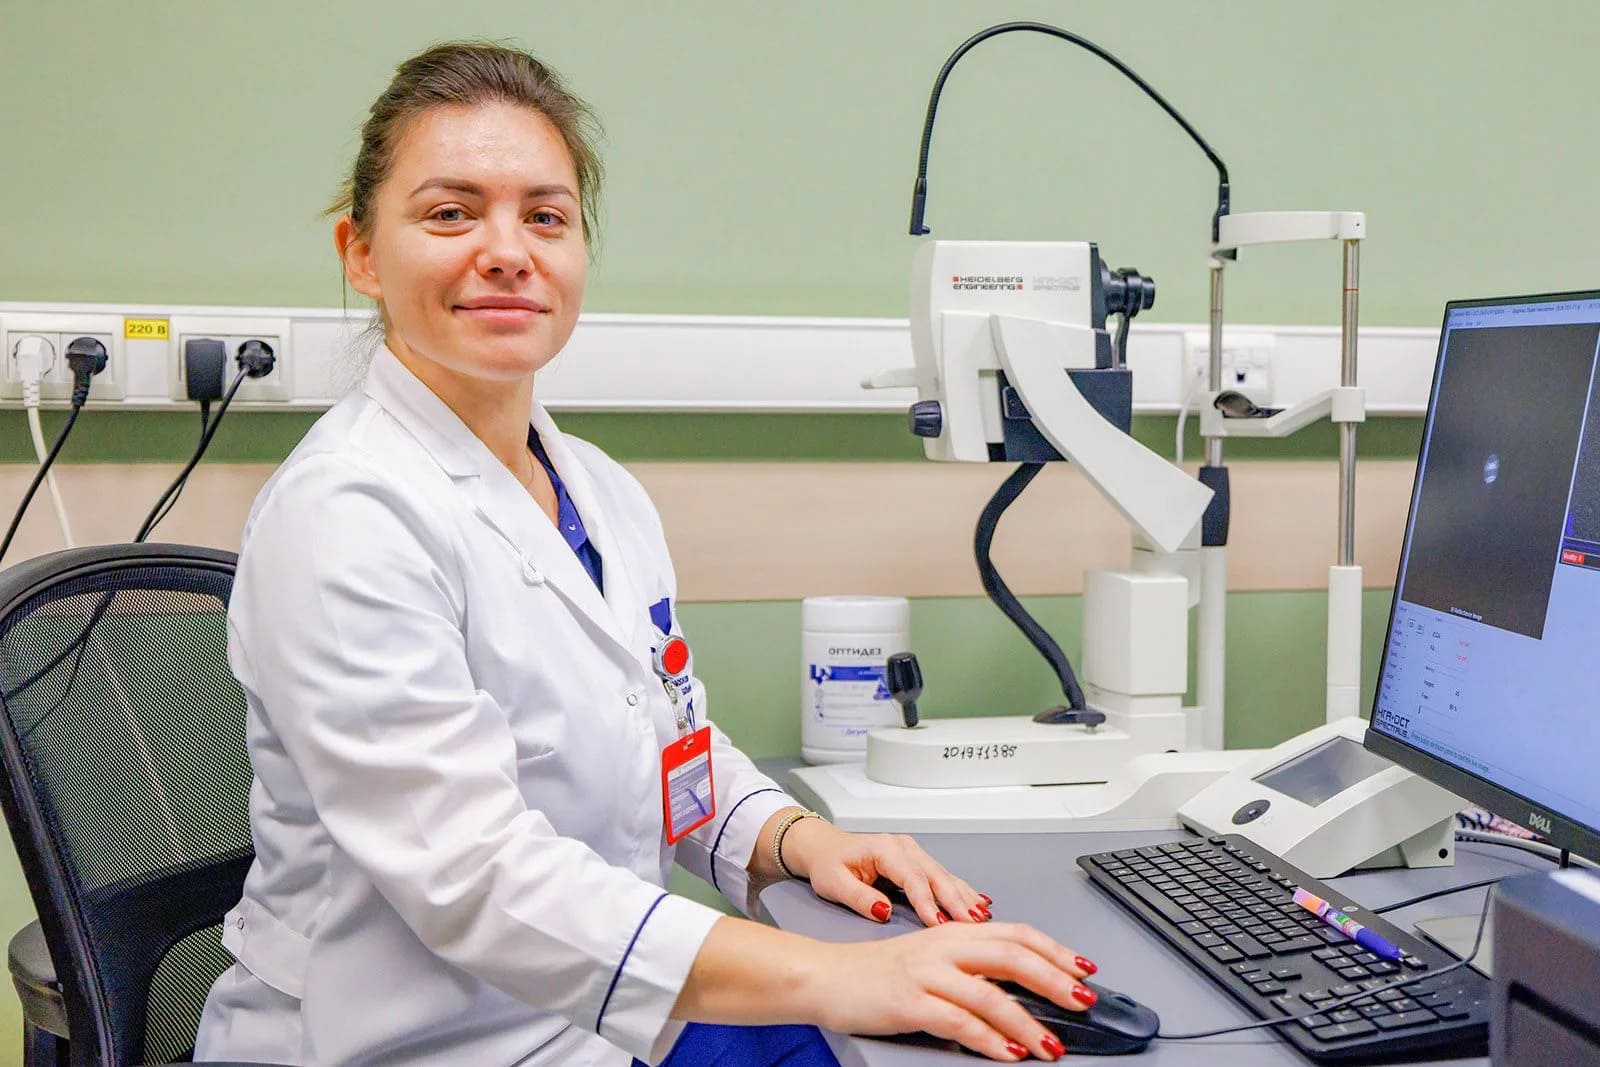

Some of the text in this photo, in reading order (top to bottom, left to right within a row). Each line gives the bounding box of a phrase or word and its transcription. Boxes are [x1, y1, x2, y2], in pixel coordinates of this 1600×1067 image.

[128, 324, 153, 335] 220
[828, 647, 881, 656] ОПТИДЕЗ
[1528, 811, 1552, 835] DELL
